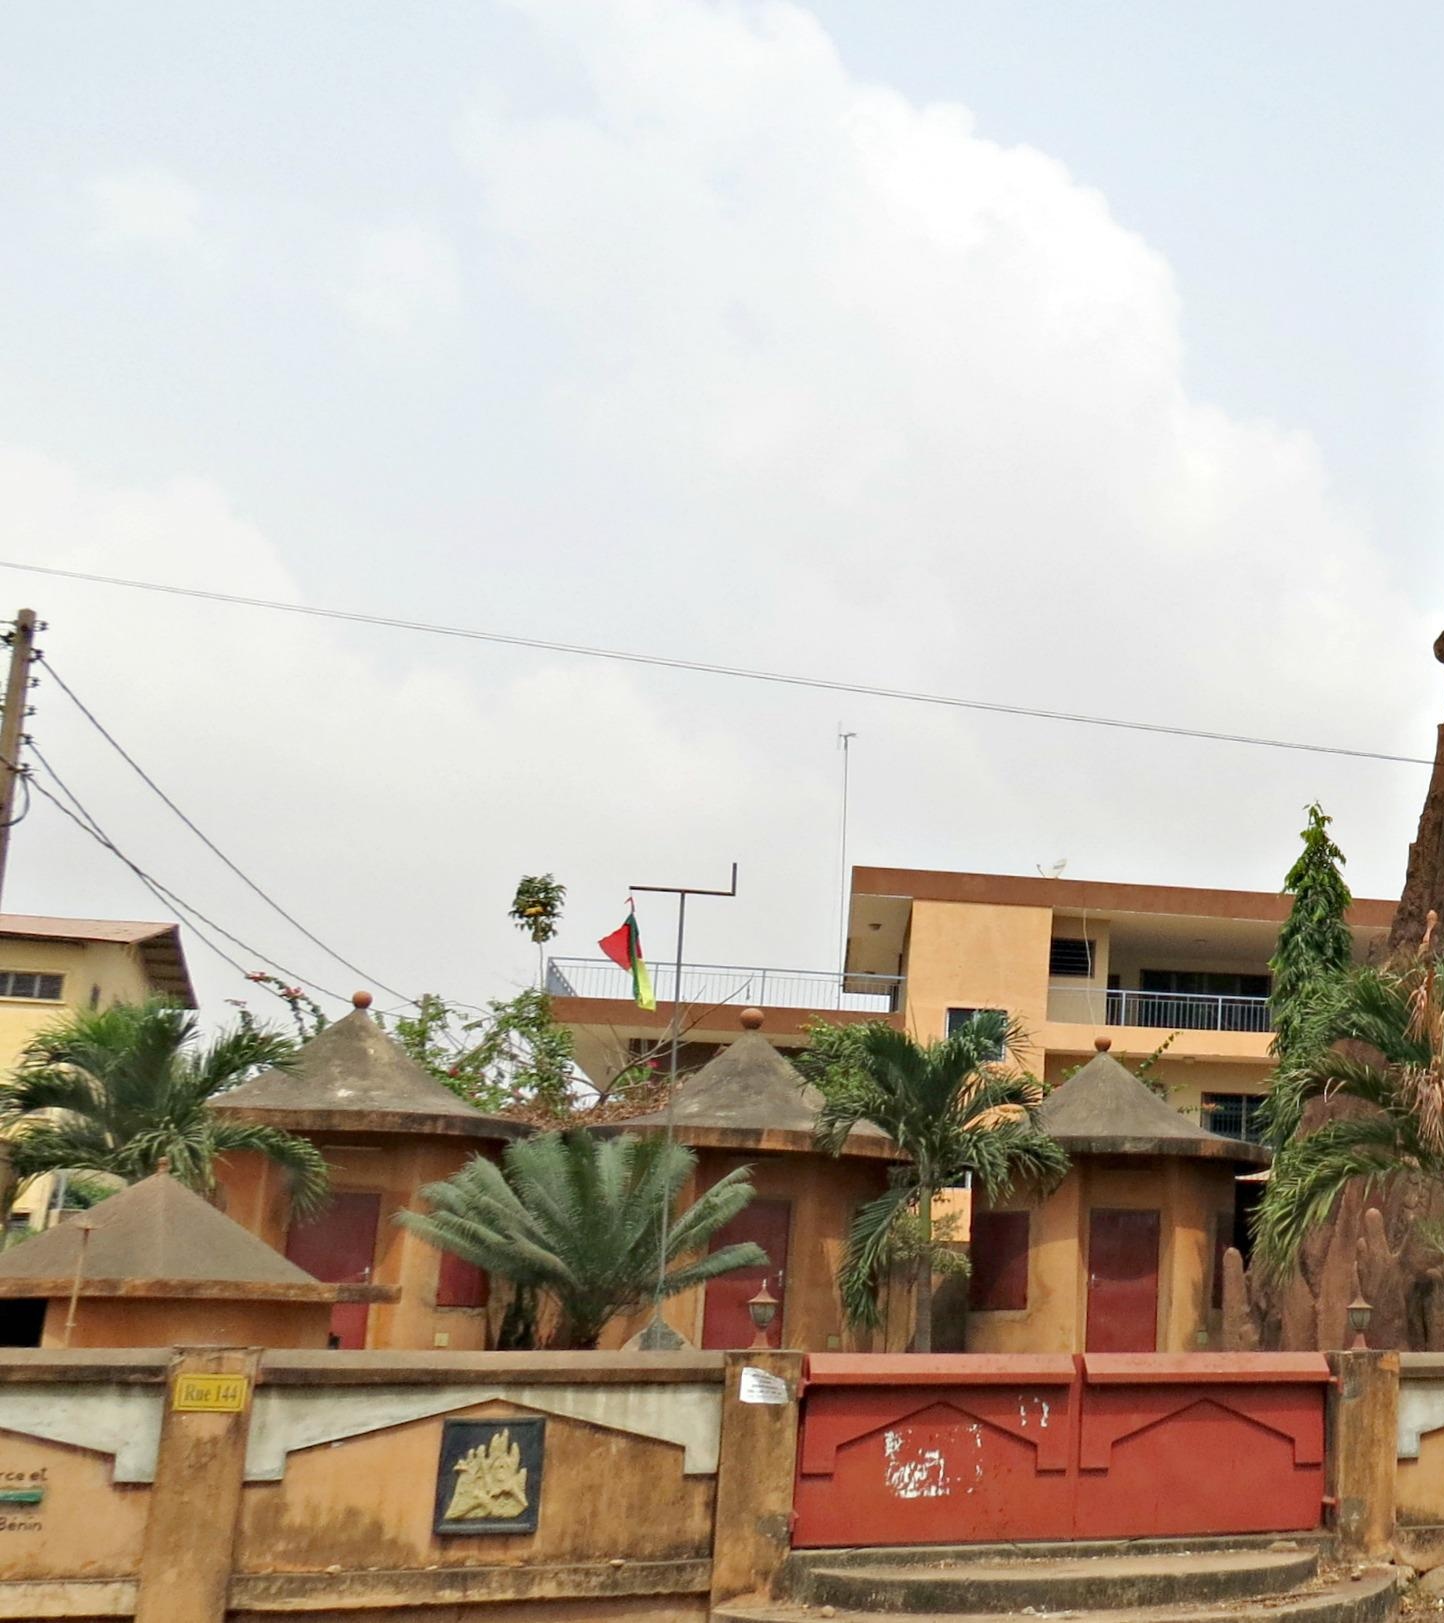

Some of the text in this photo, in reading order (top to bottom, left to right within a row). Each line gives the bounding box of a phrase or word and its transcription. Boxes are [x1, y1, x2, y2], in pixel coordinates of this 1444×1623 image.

[183, 1384, 238, 1402] Rue 144
[29, 1466, 48, 1481] et
